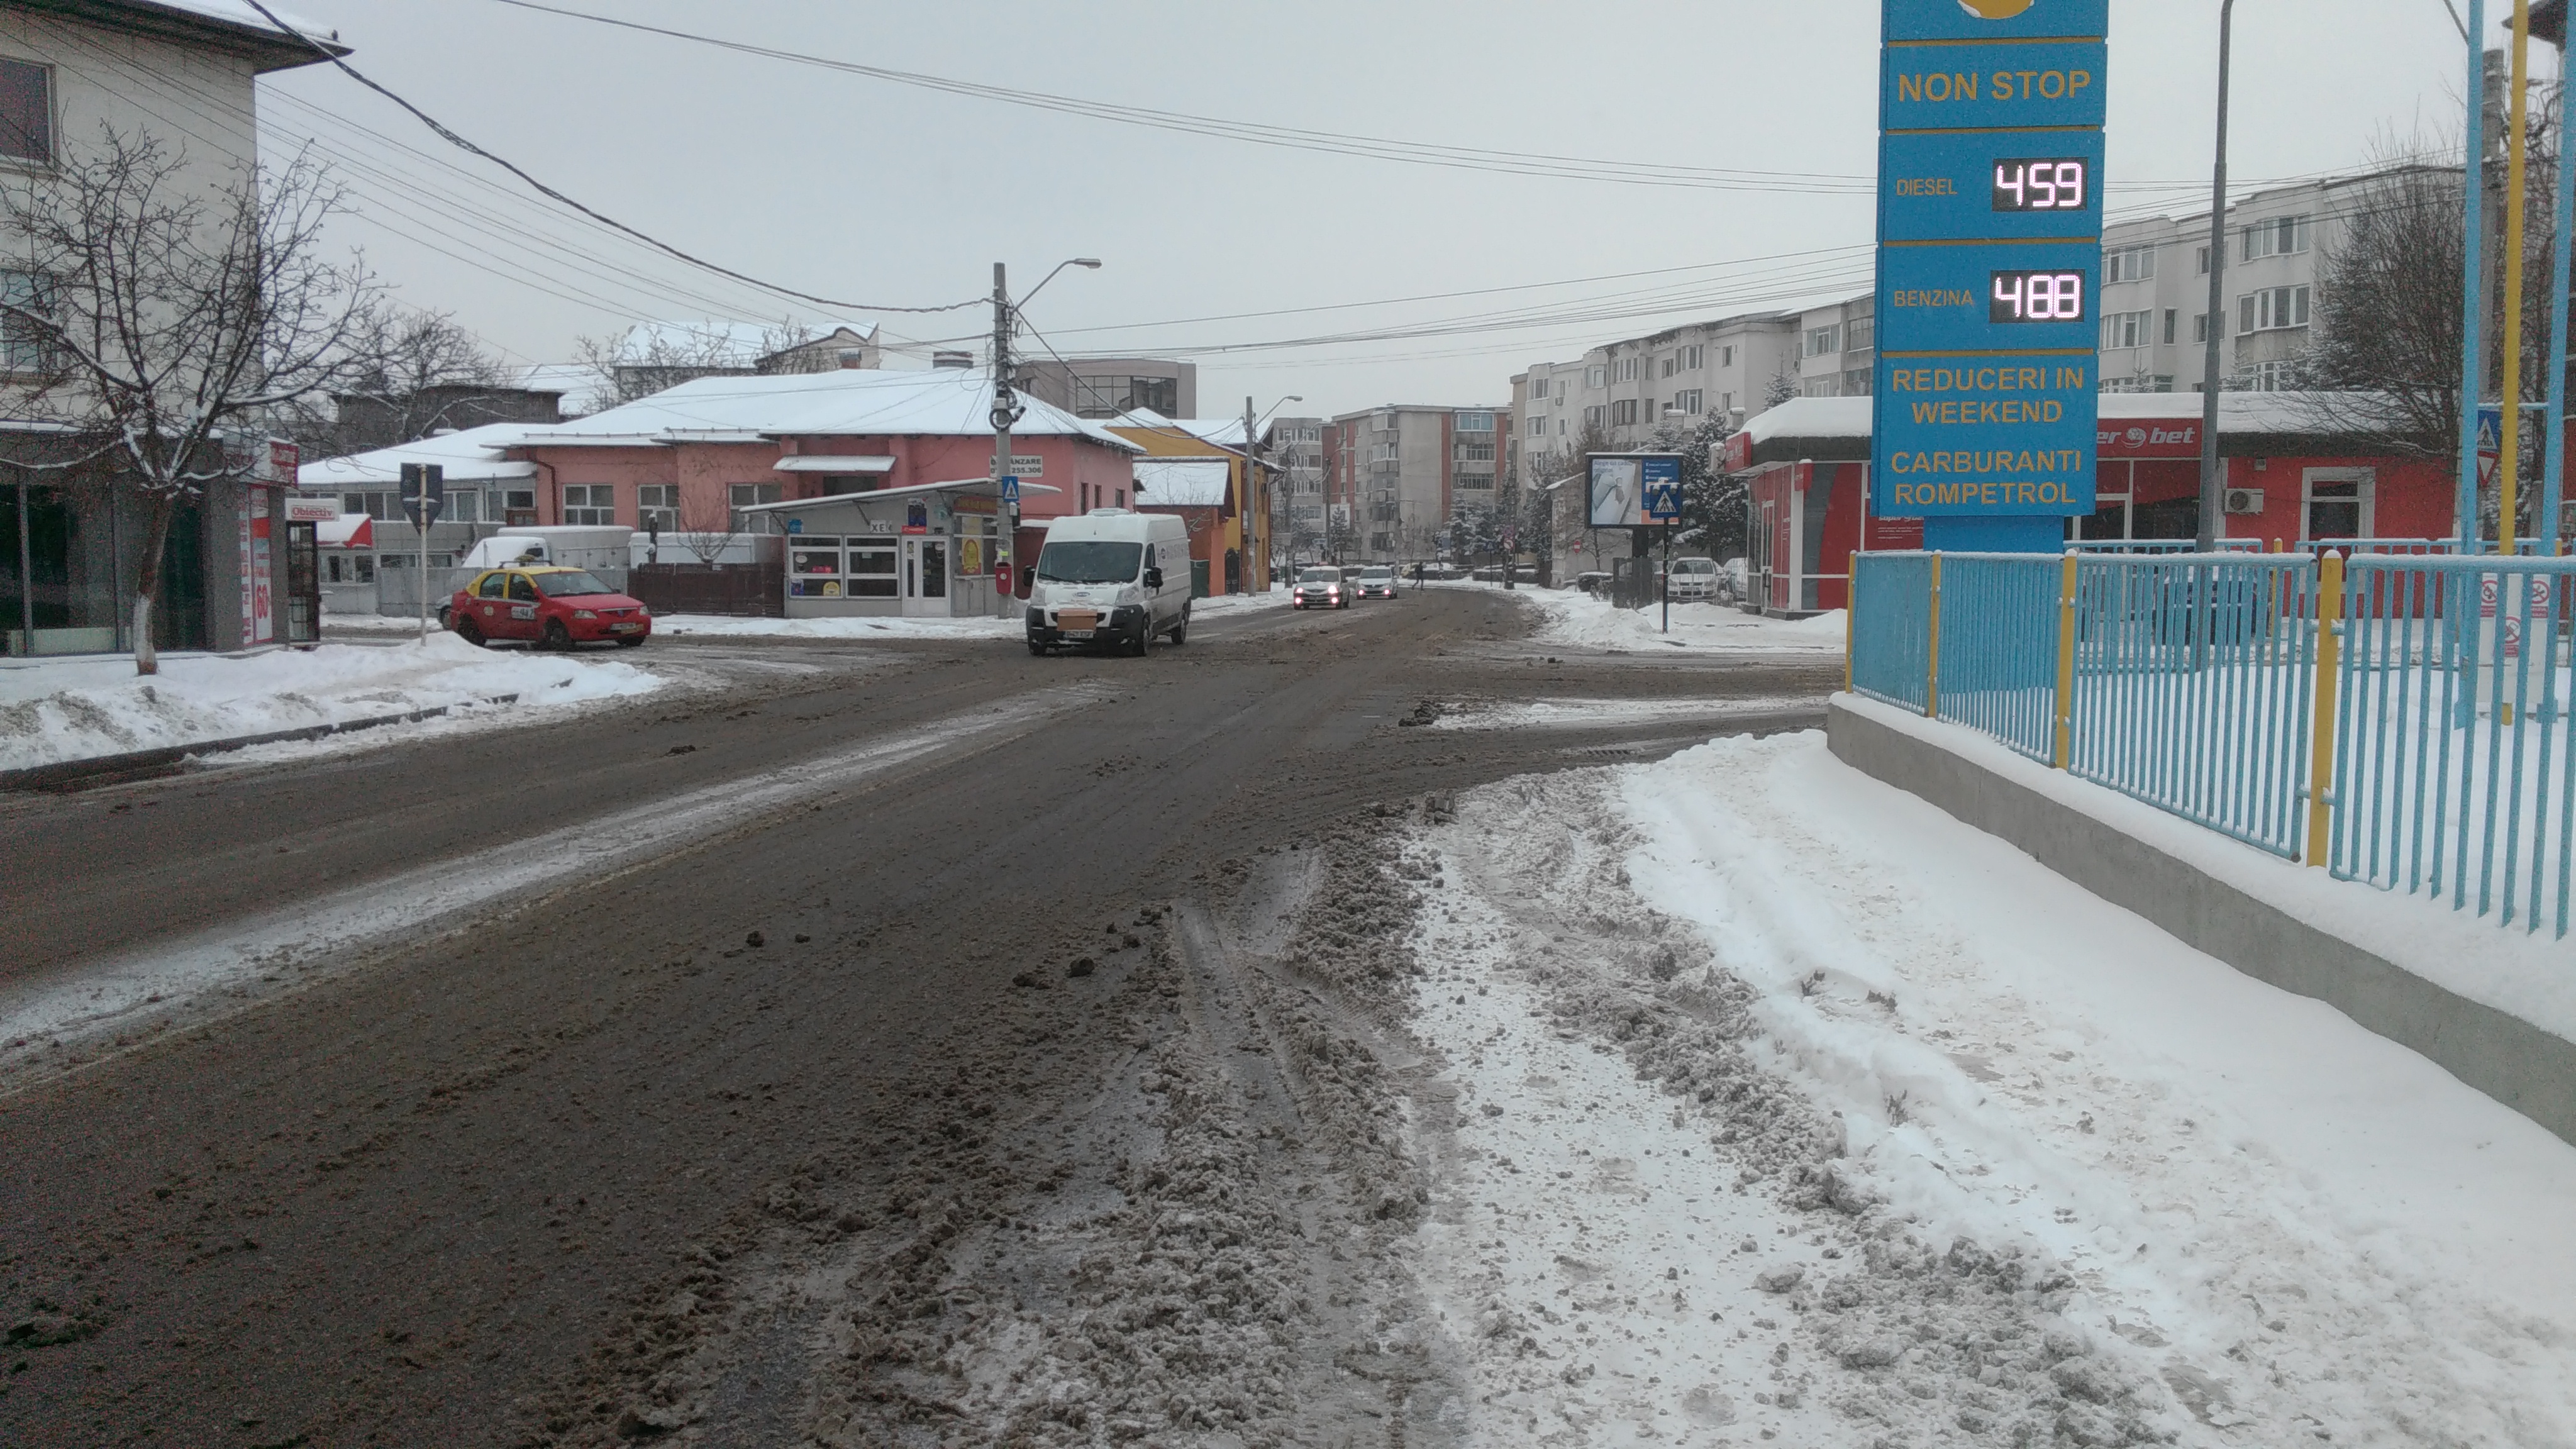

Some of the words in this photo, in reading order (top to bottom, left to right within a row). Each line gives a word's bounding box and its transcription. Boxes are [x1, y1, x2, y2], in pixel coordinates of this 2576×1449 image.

[1898, 72, 1978, 102] NON
[1991, 70, 2090, 100] STOP
[1896, 179, 1958, 196] DIESEL
[1996, 163, 2082, 207] 459
[1894, 289, 1974, 307] BENZINA
[1995, 275, 2080, 318] 488
[1892, 367, 2046, 392] REDUCERI
[2057, 367, 2084, 389] IN
[1912, 400, 2063, 423] WEEKEND
[2097, 431, 2122, 444] er
[2149, 427, 2196, 444] bet
[1891, 450, 2081, 473] CARBURANTI
[1895, 482, 2077, 504] ROMPETROL
